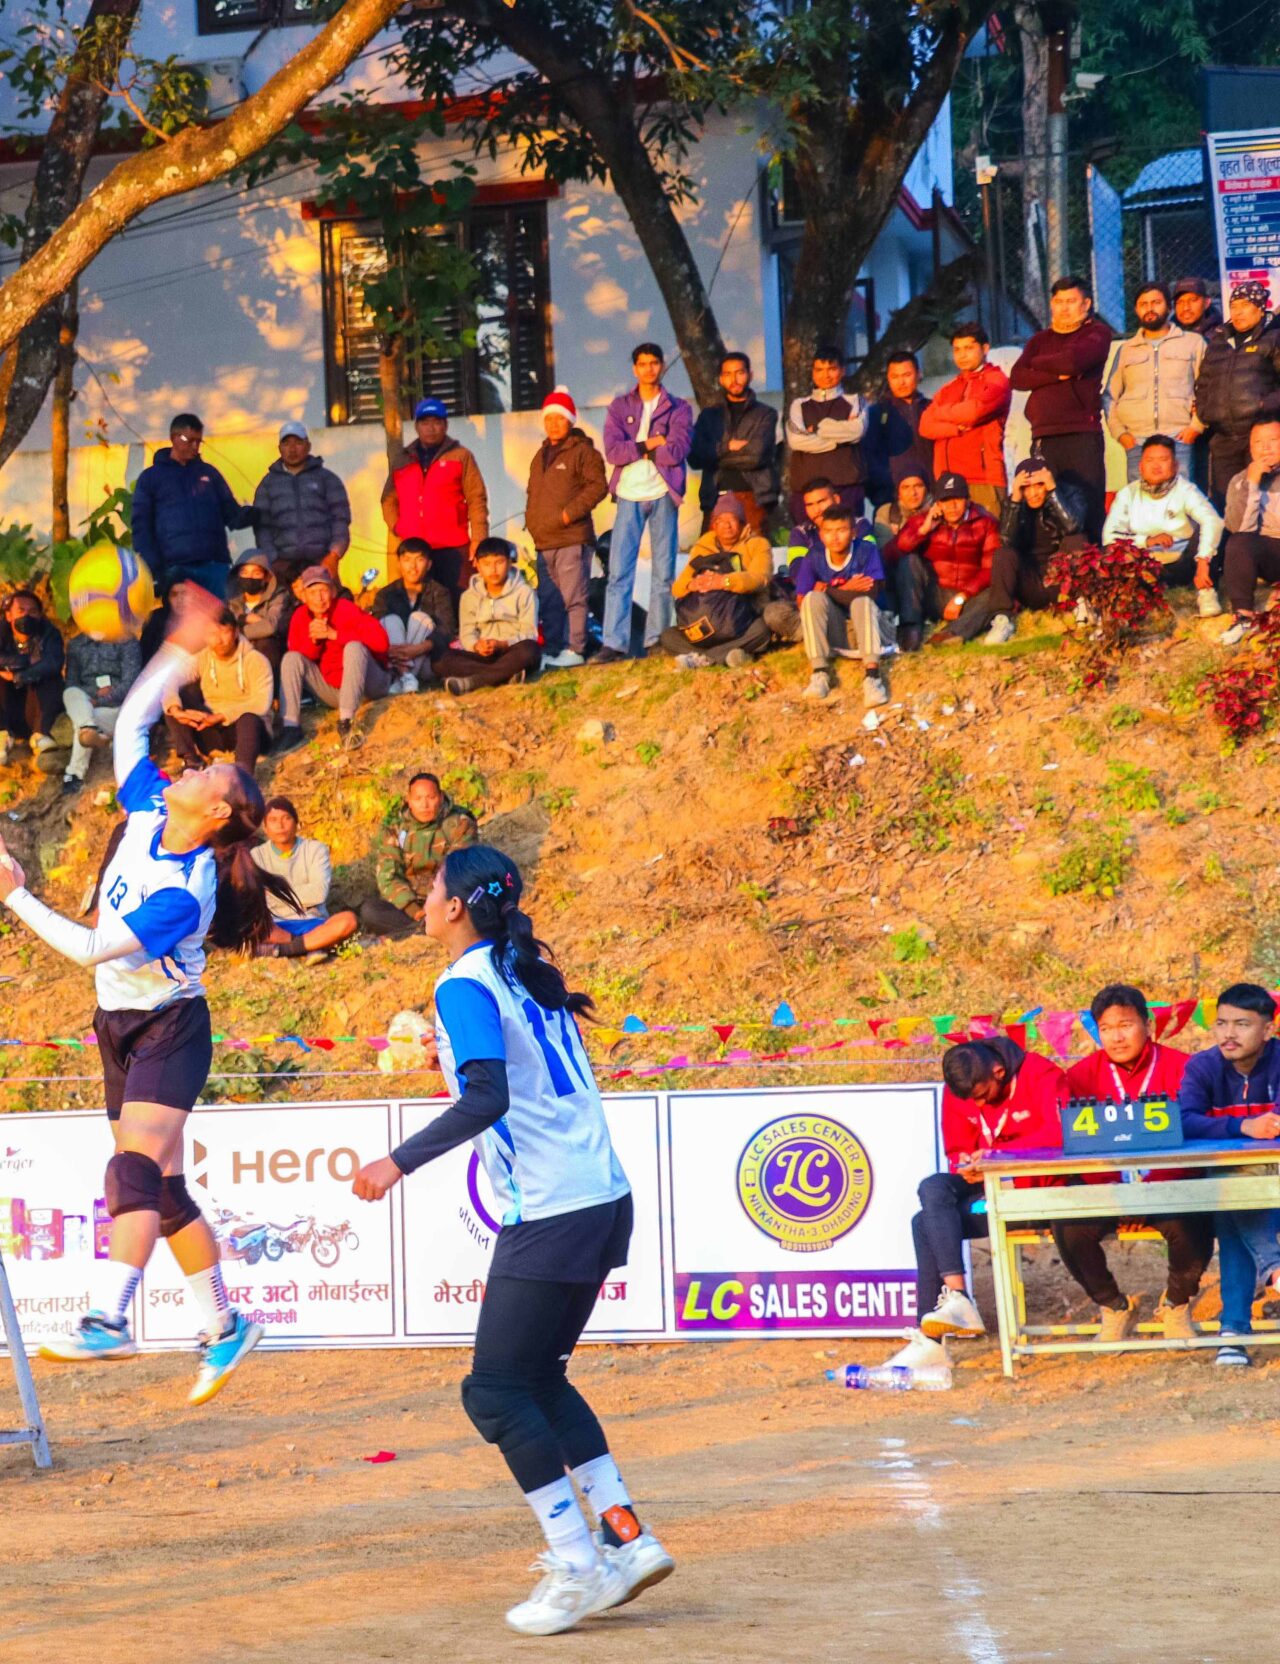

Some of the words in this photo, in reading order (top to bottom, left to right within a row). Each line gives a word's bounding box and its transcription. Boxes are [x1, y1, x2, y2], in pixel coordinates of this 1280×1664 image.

[107, 874, 128, 910] 13
[1073, 1107, 1099, 1136] 4
[1104, 1105, 1118, 1122] 0
[1124, 1104, 1134, 1120] 1
[1144, 1101, 1170, 1131] 5
[763, 1121, 807, 1145] SALES
[812, 1122, 860, 1162] CENTER
[821, 1191, 863, 1234] DHADING
[262, 1279, 299, 1303] अटो
[682, 1280, 744, 1320] LC
[749, 1282, 828, 1319] SALES
[834, 1281, 917, 1317] CENTE
